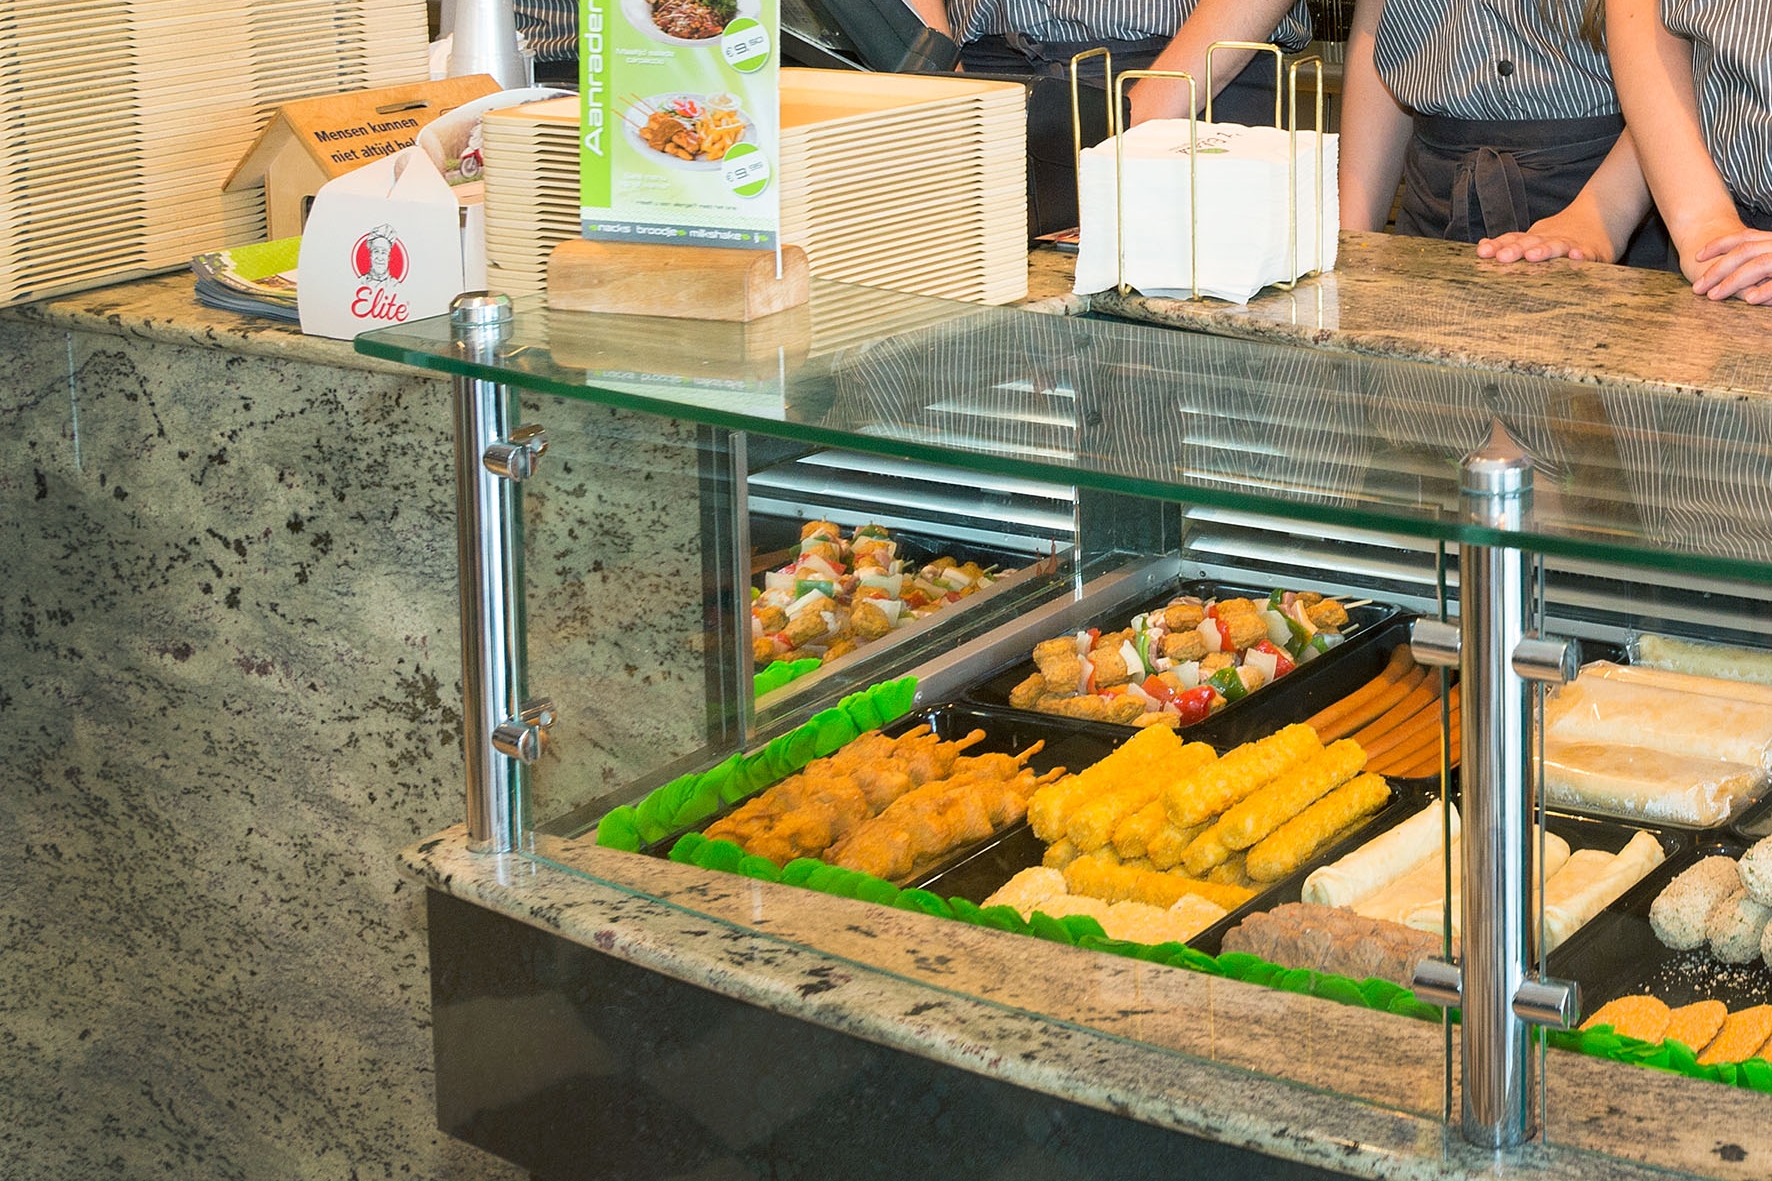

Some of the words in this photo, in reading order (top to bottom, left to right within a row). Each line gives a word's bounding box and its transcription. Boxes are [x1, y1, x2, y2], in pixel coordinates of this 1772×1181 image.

[314, 125, 369, 143] Mensen
[367, 118, 419, 133] kunnen
[331, 150, 360, 163] niet
[361, 140, 395, 158] altijd
[351, 285, 409, 322] Elite
